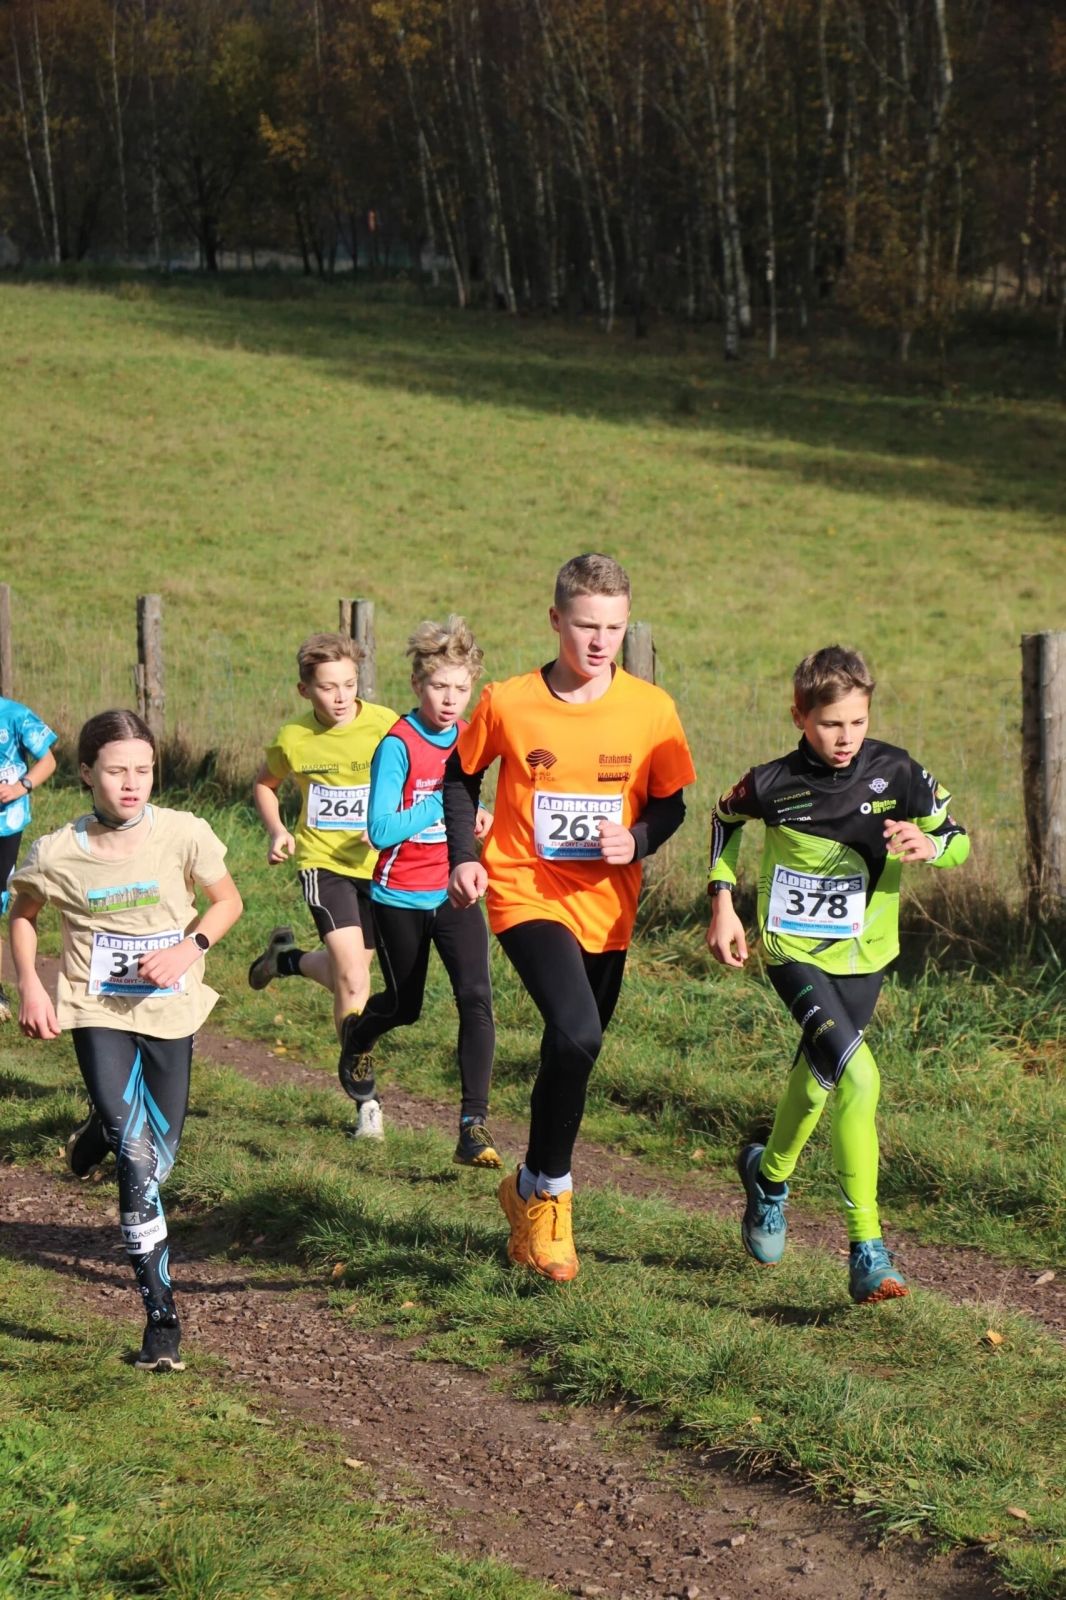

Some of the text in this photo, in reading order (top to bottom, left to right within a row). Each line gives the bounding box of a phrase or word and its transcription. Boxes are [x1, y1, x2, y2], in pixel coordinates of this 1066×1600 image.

[319, 799, 364, 817] 264
[539, 797, 621, 812] ÁDRKROS
[549, 814, 608, 841] 263
[777, 871, 861, 892] ÁDRKROS
[786, 889, 848, 918] 378
